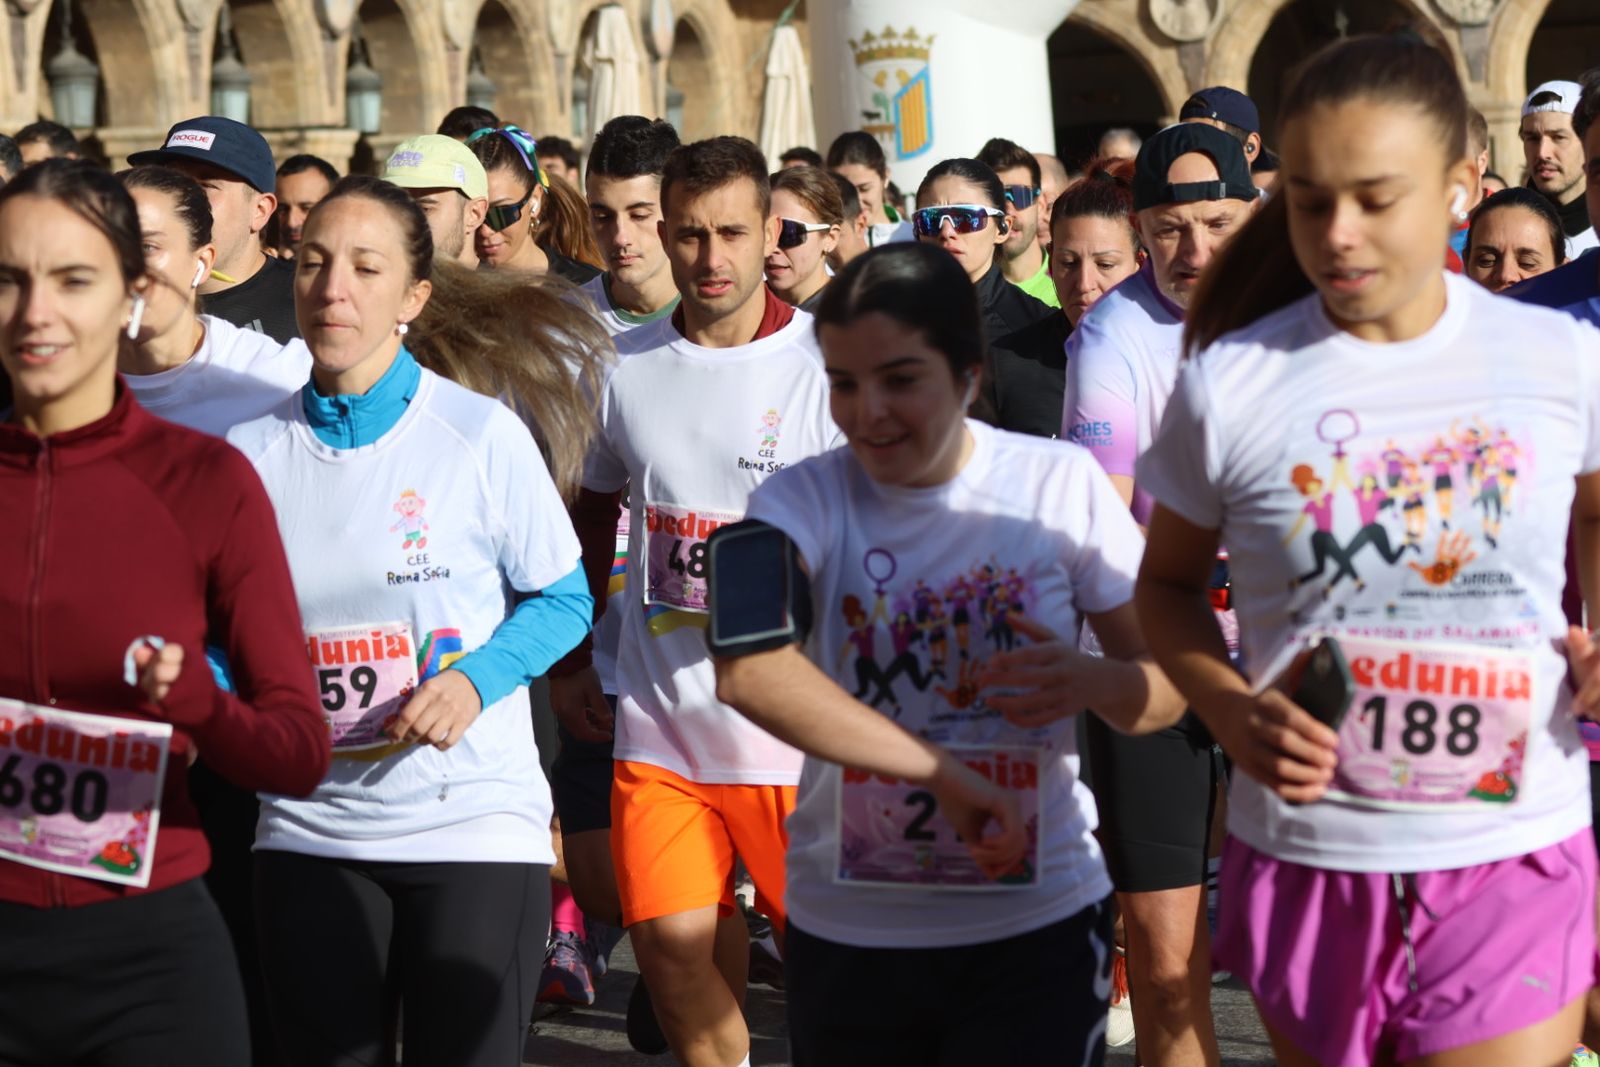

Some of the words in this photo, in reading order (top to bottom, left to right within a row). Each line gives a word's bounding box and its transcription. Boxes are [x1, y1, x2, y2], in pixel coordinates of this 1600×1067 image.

[173, 133, 210, 143] ROGUE
[758, 449, 776, 458] CEE
[738, 457, 764, 472] Reina
[407, 553, 430, 566] CEE
[668, 540, 708, 579] 48
[387, 571, 420, 586] Reina
[1351, 652, 1531, 699] edunia
[319, 666, 378, 712] 59
[1363, 695, 1481, 757] 188
